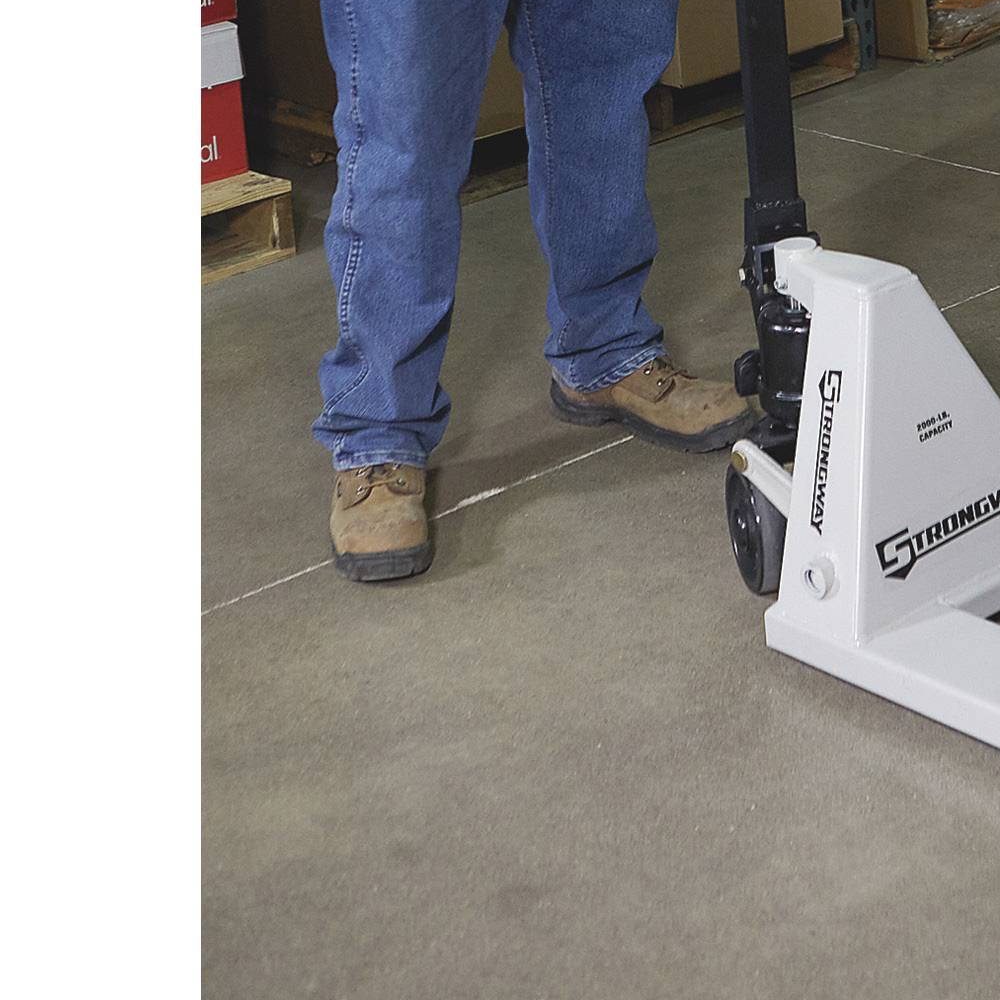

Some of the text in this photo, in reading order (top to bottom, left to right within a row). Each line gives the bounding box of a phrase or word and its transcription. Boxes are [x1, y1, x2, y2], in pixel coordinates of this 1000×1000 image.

[916, 410, 951, 432] 2000-LB.
[918, 419, 953, 443] CAPACITY
[811, 370, 843, 537] STRONGWAY
